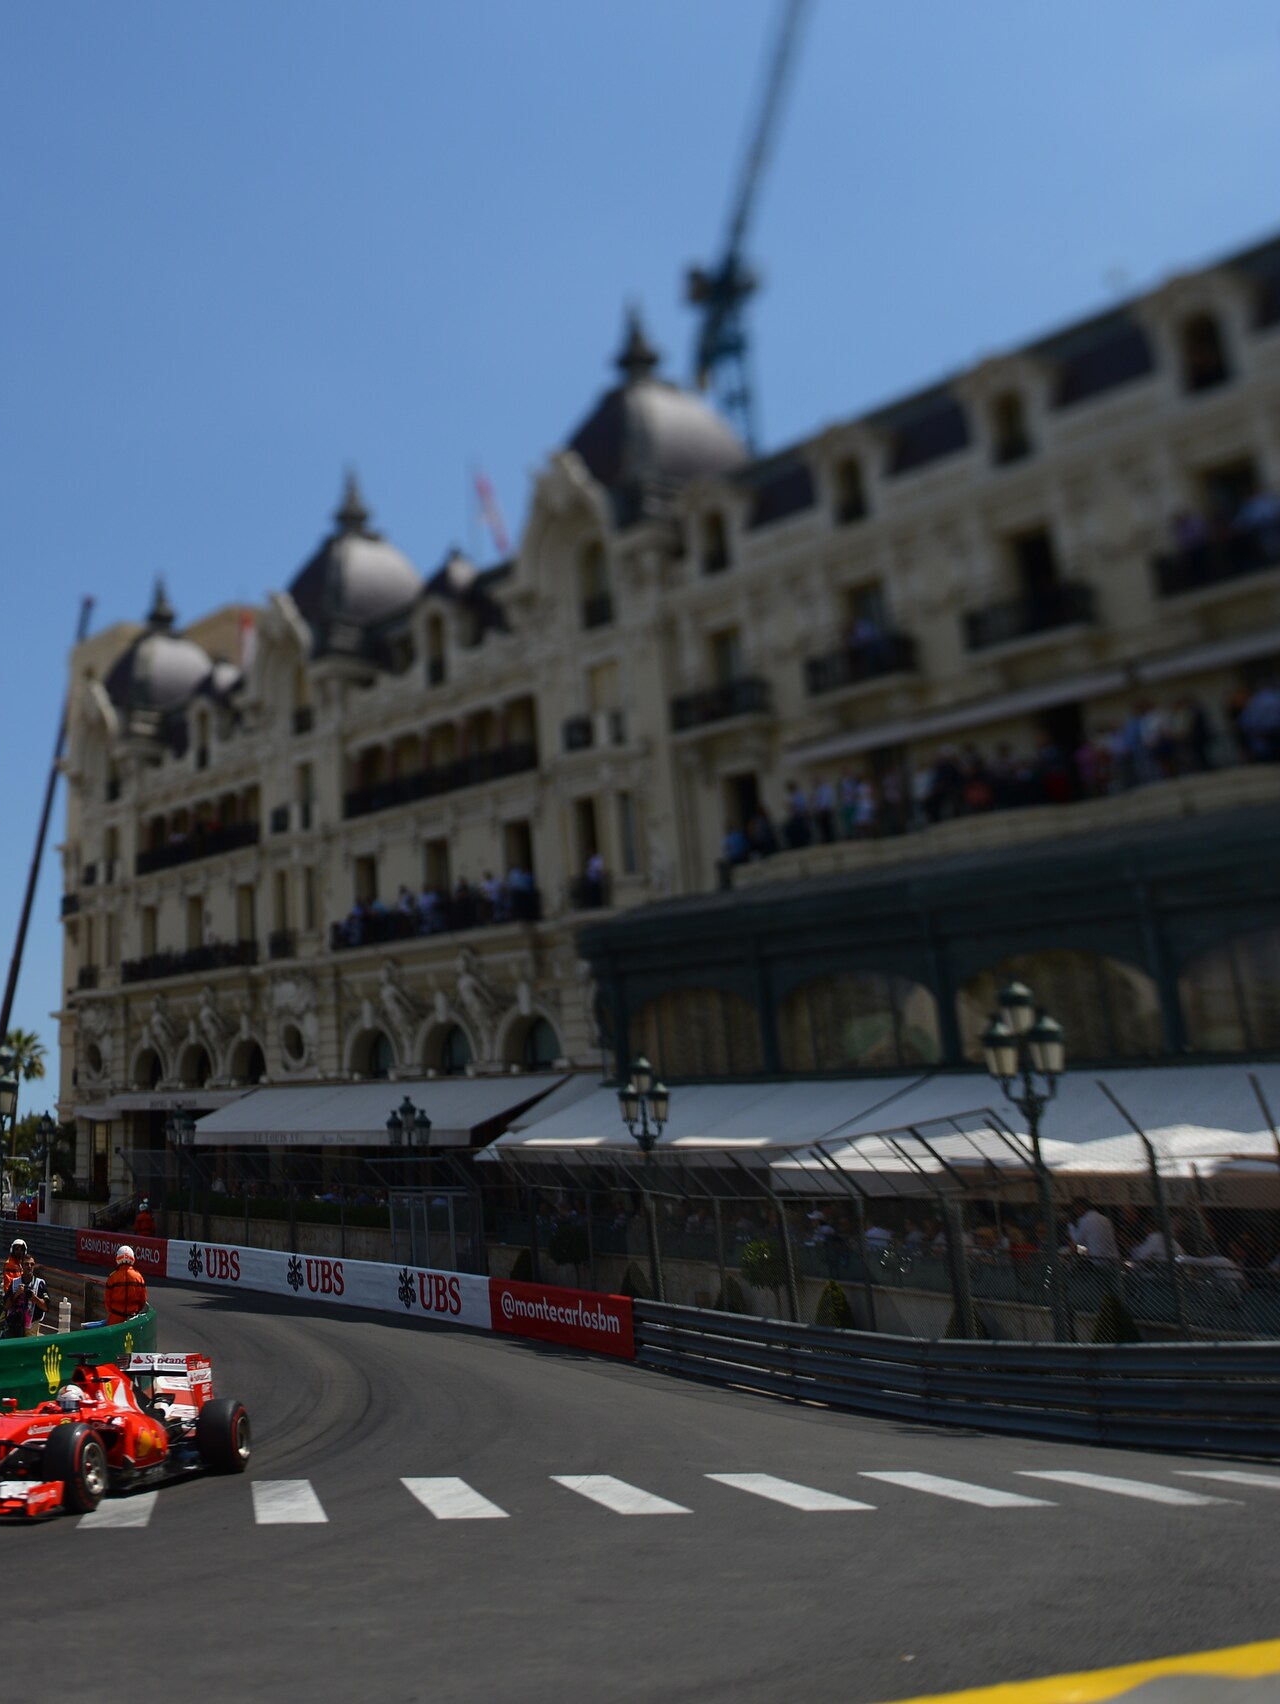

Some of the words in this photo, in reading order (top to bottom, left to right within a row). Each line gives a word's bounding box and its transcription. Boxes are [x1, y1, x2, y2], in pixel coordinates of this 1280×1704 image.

[80, 1237, 101, 1252] CASINO
[102, 1241, 111, 1255] DE
[205, 1248, 241, 1281] UBS
[305, 1258, 345, 1296] UBS
[417, 1272, 462, 1315] UBS
[500, 1291, 620, 1334] @montecarlosbm
